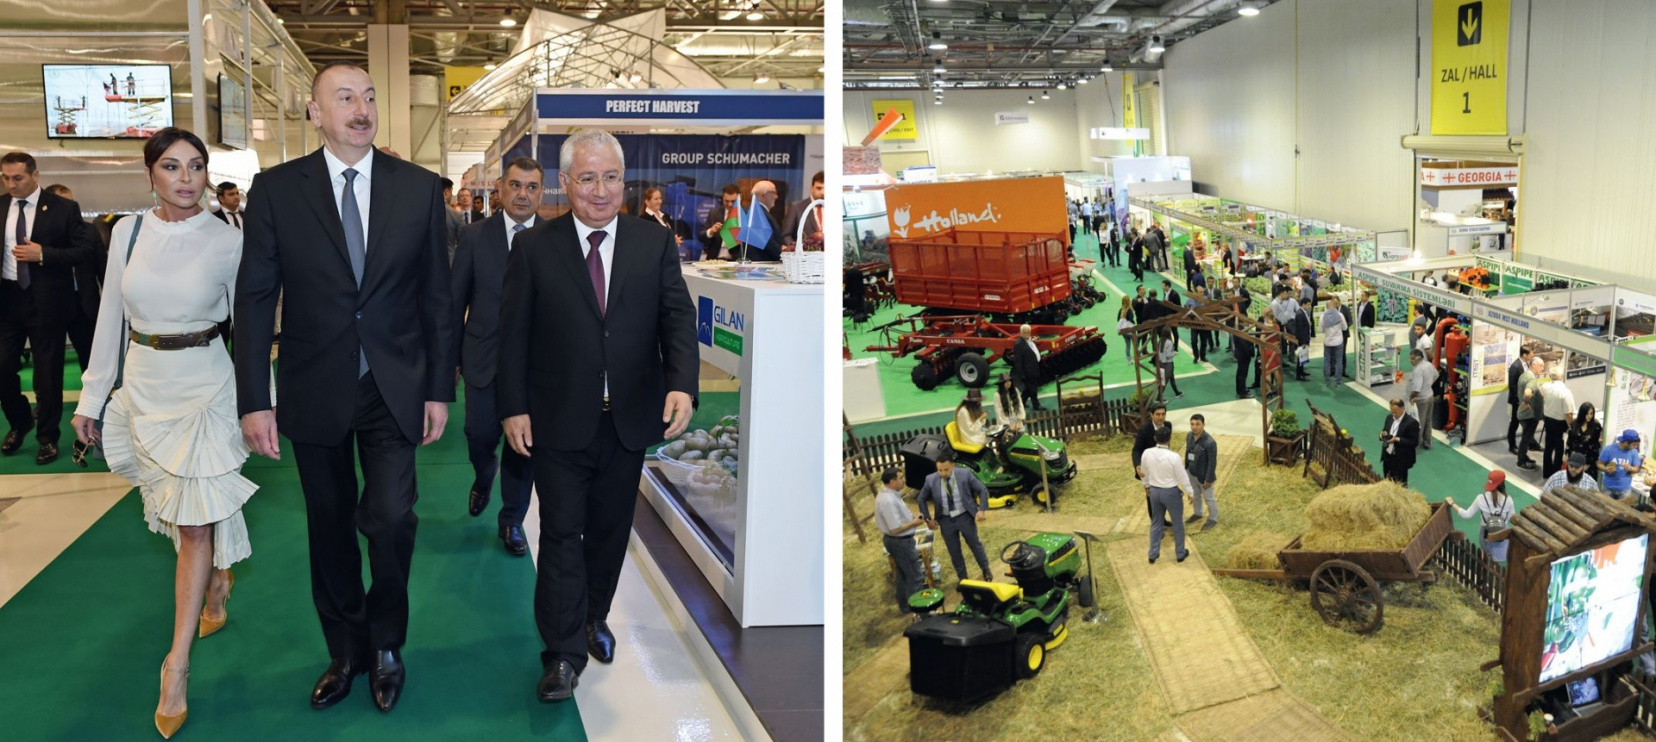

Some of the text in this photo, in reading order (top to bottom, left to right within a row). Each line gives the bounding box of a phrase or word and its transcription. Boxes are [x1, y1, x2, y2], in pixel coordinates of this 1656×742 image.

[1441, 64, 1497, 83] ZAL / HALL
[606, 100, 700, 113] PERFECT HARVEST
[1462, 91, 1471, 113] 1
[662, 153, 790, 165] GROUP SCHUMACHER
[1458, 172, 1502, 183] GEORGIA
[1505, 265, 1534, 278] ASPIPE
[1357, 271, 1378, 283] ASPIPE
[1382, 279, 1411, 294] SUVARMA
[714, 305, 744, 332] GILAN
